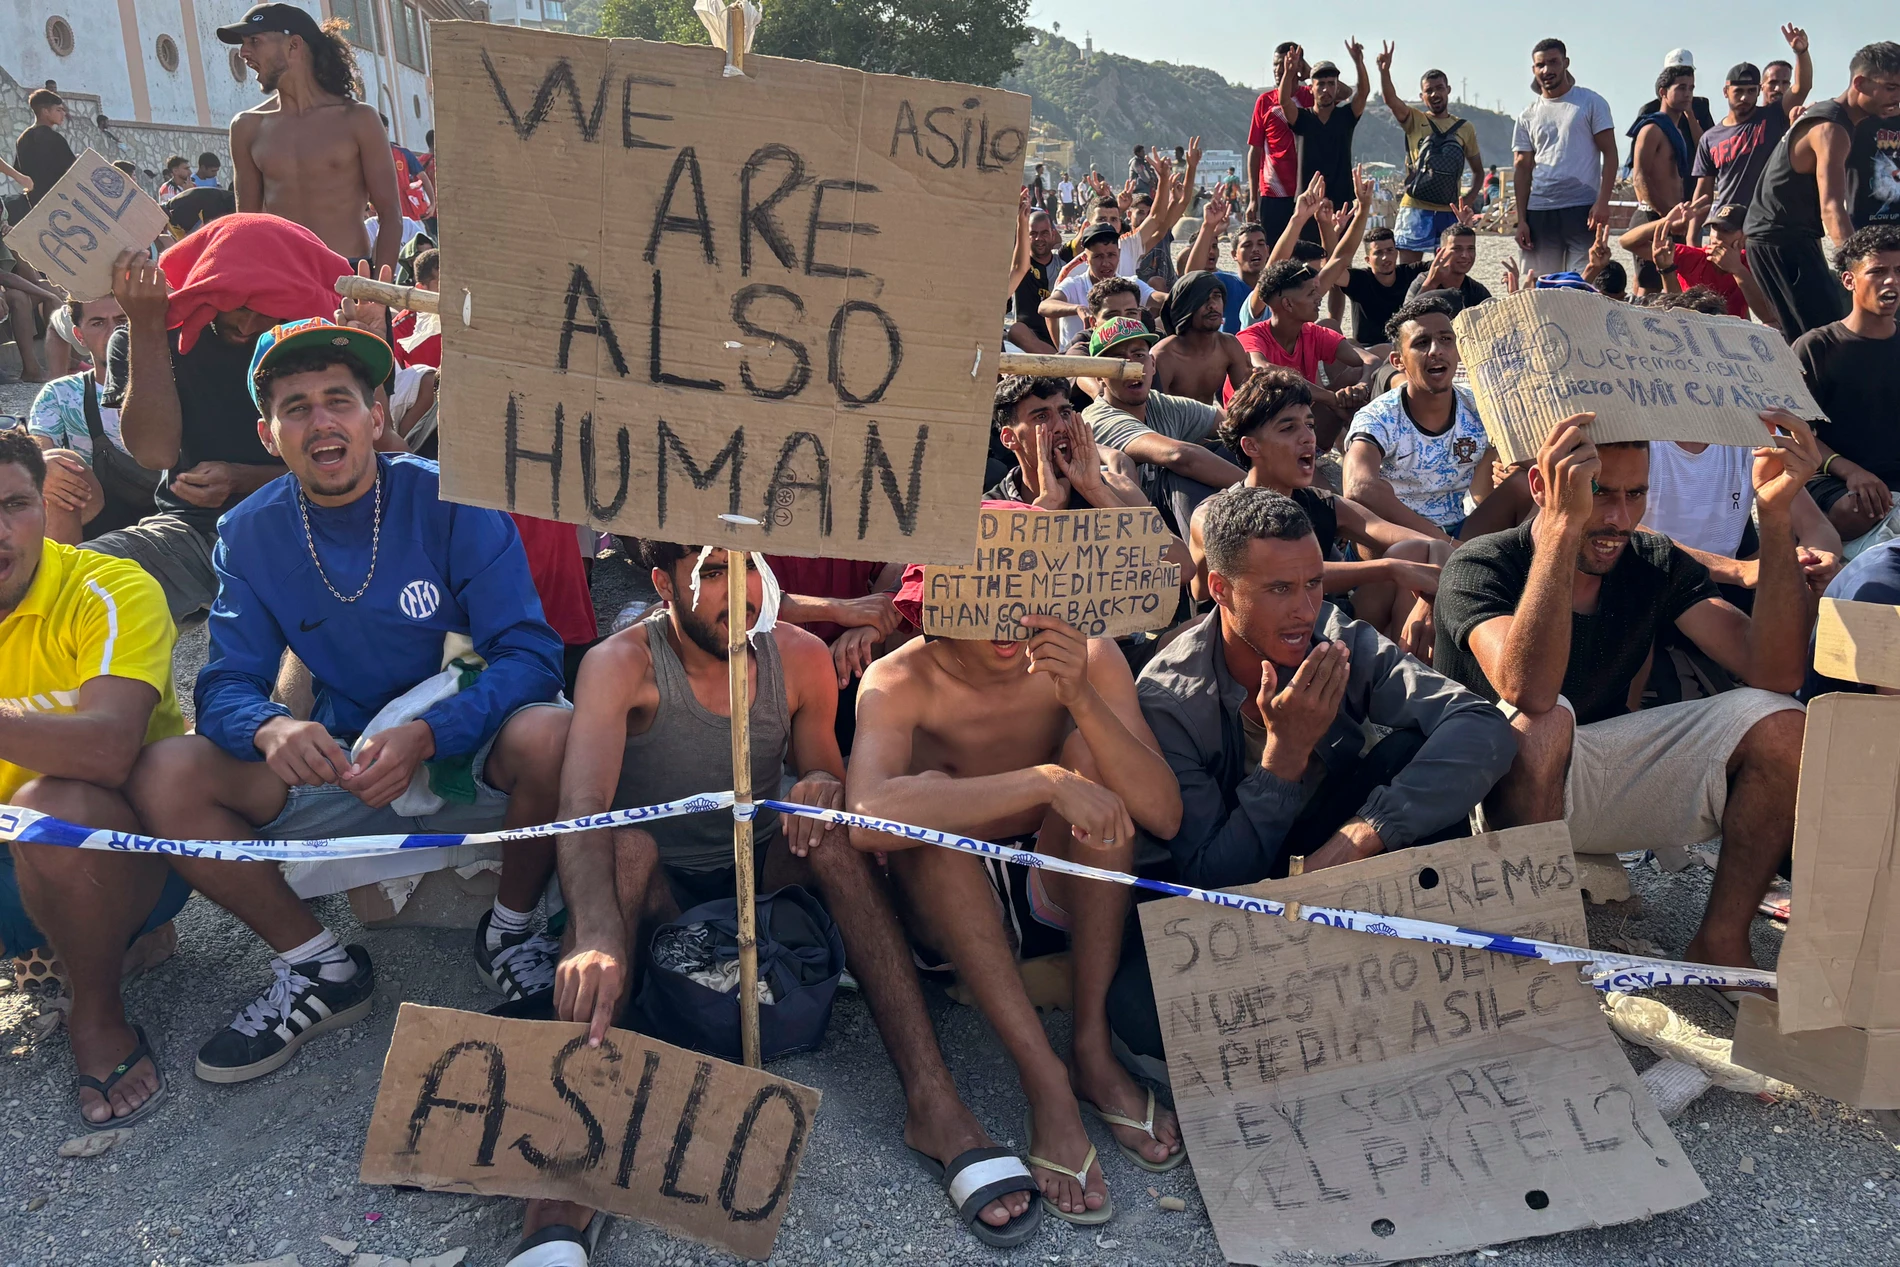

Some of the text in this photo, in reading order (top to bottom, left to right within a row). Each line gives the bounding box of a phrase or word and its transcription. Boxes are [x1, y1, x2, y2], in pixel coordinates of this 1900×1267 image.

[480, 47, 678, 150] WE
[643, 142, 884, 278] ARE
[557, 262, 904, 408] ALSO
[502, 391, 930, 541] HUMAN
[976, 547, 1070, 572] HROW
[1076, 544, 1110, 570] MY
[1010, 511, 1133, 543] RATHER
[1140, 511, 1165, 535] TO
[924, 601, 990, 628] THAN
[997, 601, 1062, 626] GOING
[1030, 565, 1182, 599] MEDITERRANE
[1341, 854, 1575, 917] QUEREMOS
[1168, 951, 1418, 1036] NUESTRO
[1410, 970, 1564, 1053] ASILO
[395, 1033, 808, 1222] ASILO
